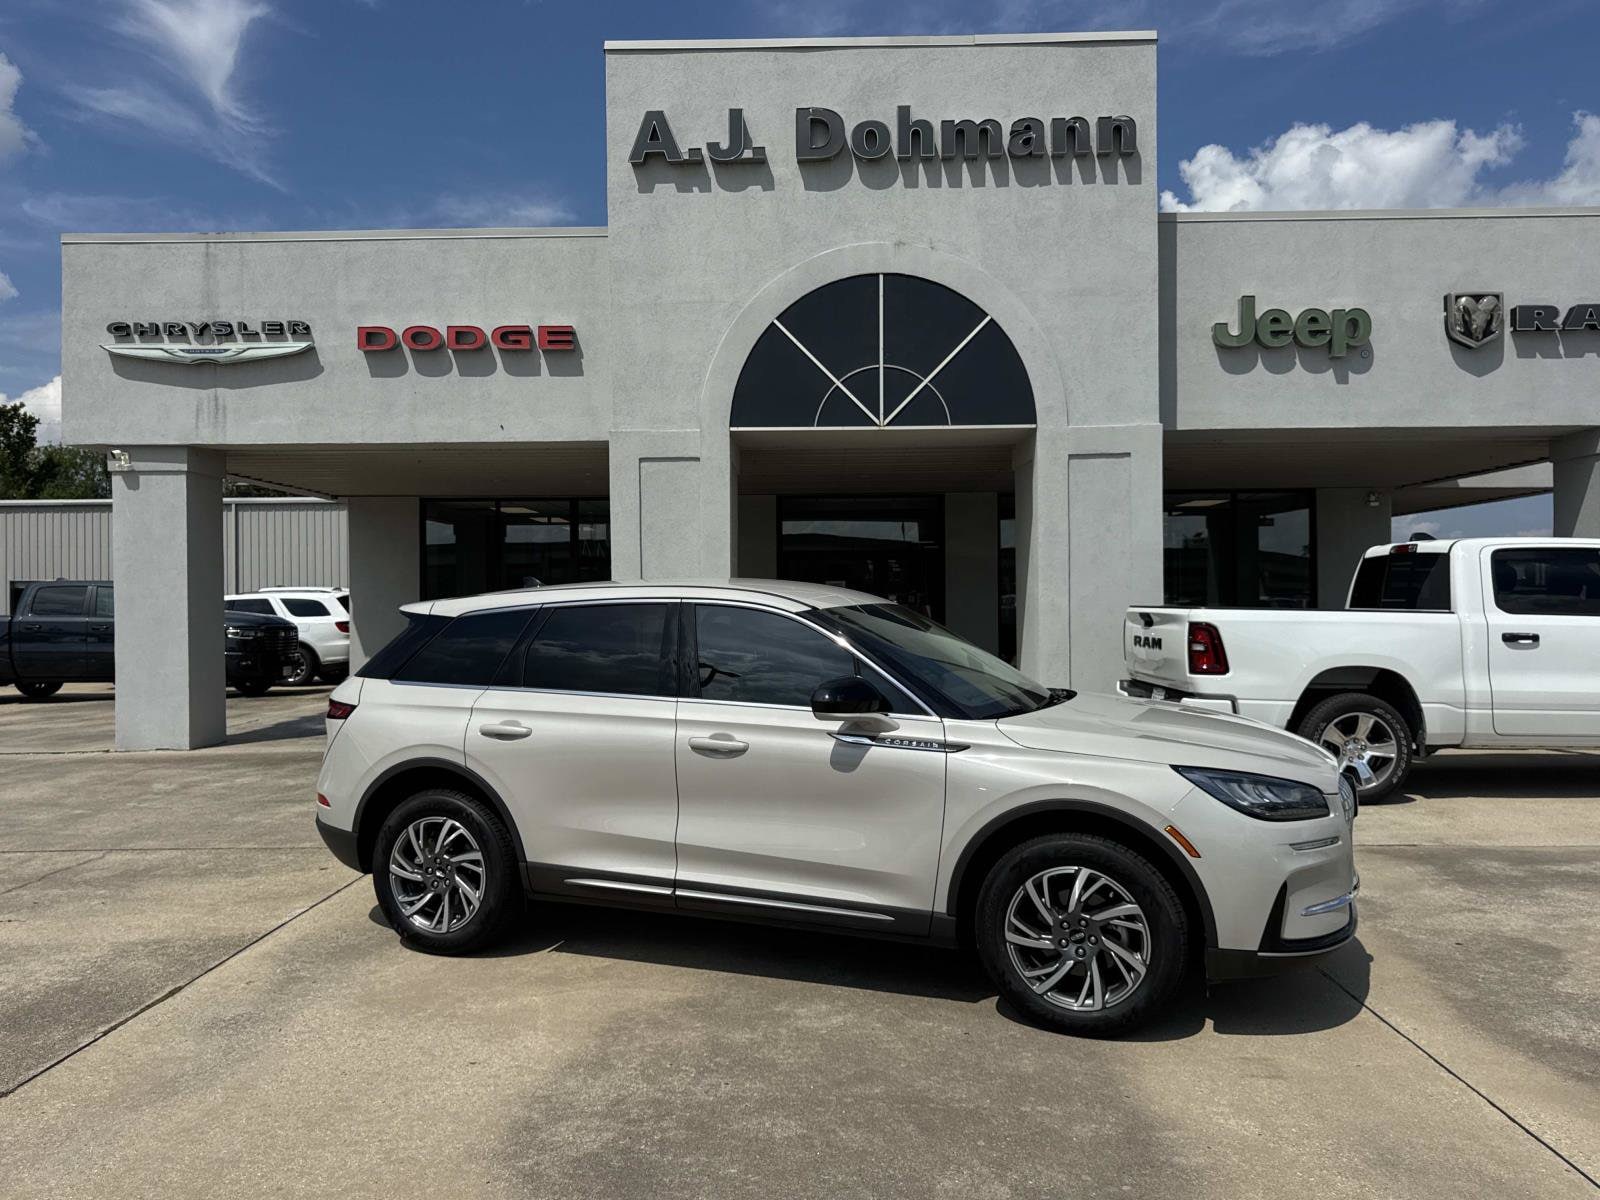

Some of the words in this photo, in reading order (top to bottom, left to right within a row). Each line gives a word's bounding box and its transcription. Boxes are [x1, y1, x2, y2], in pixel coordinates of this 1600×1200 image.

[628, 108, 765, 164] A.J.
[796, 105, 1137, 163] Dohmann
[106, 321, 310, 337] CHRYSLER
[1212, 295, 1372, 359] Jeep
[357, 325, 577, 352] DODGE
[1133, 635, 1162, 650] RAM
[884, 738, 939, 748] CORSAIR
